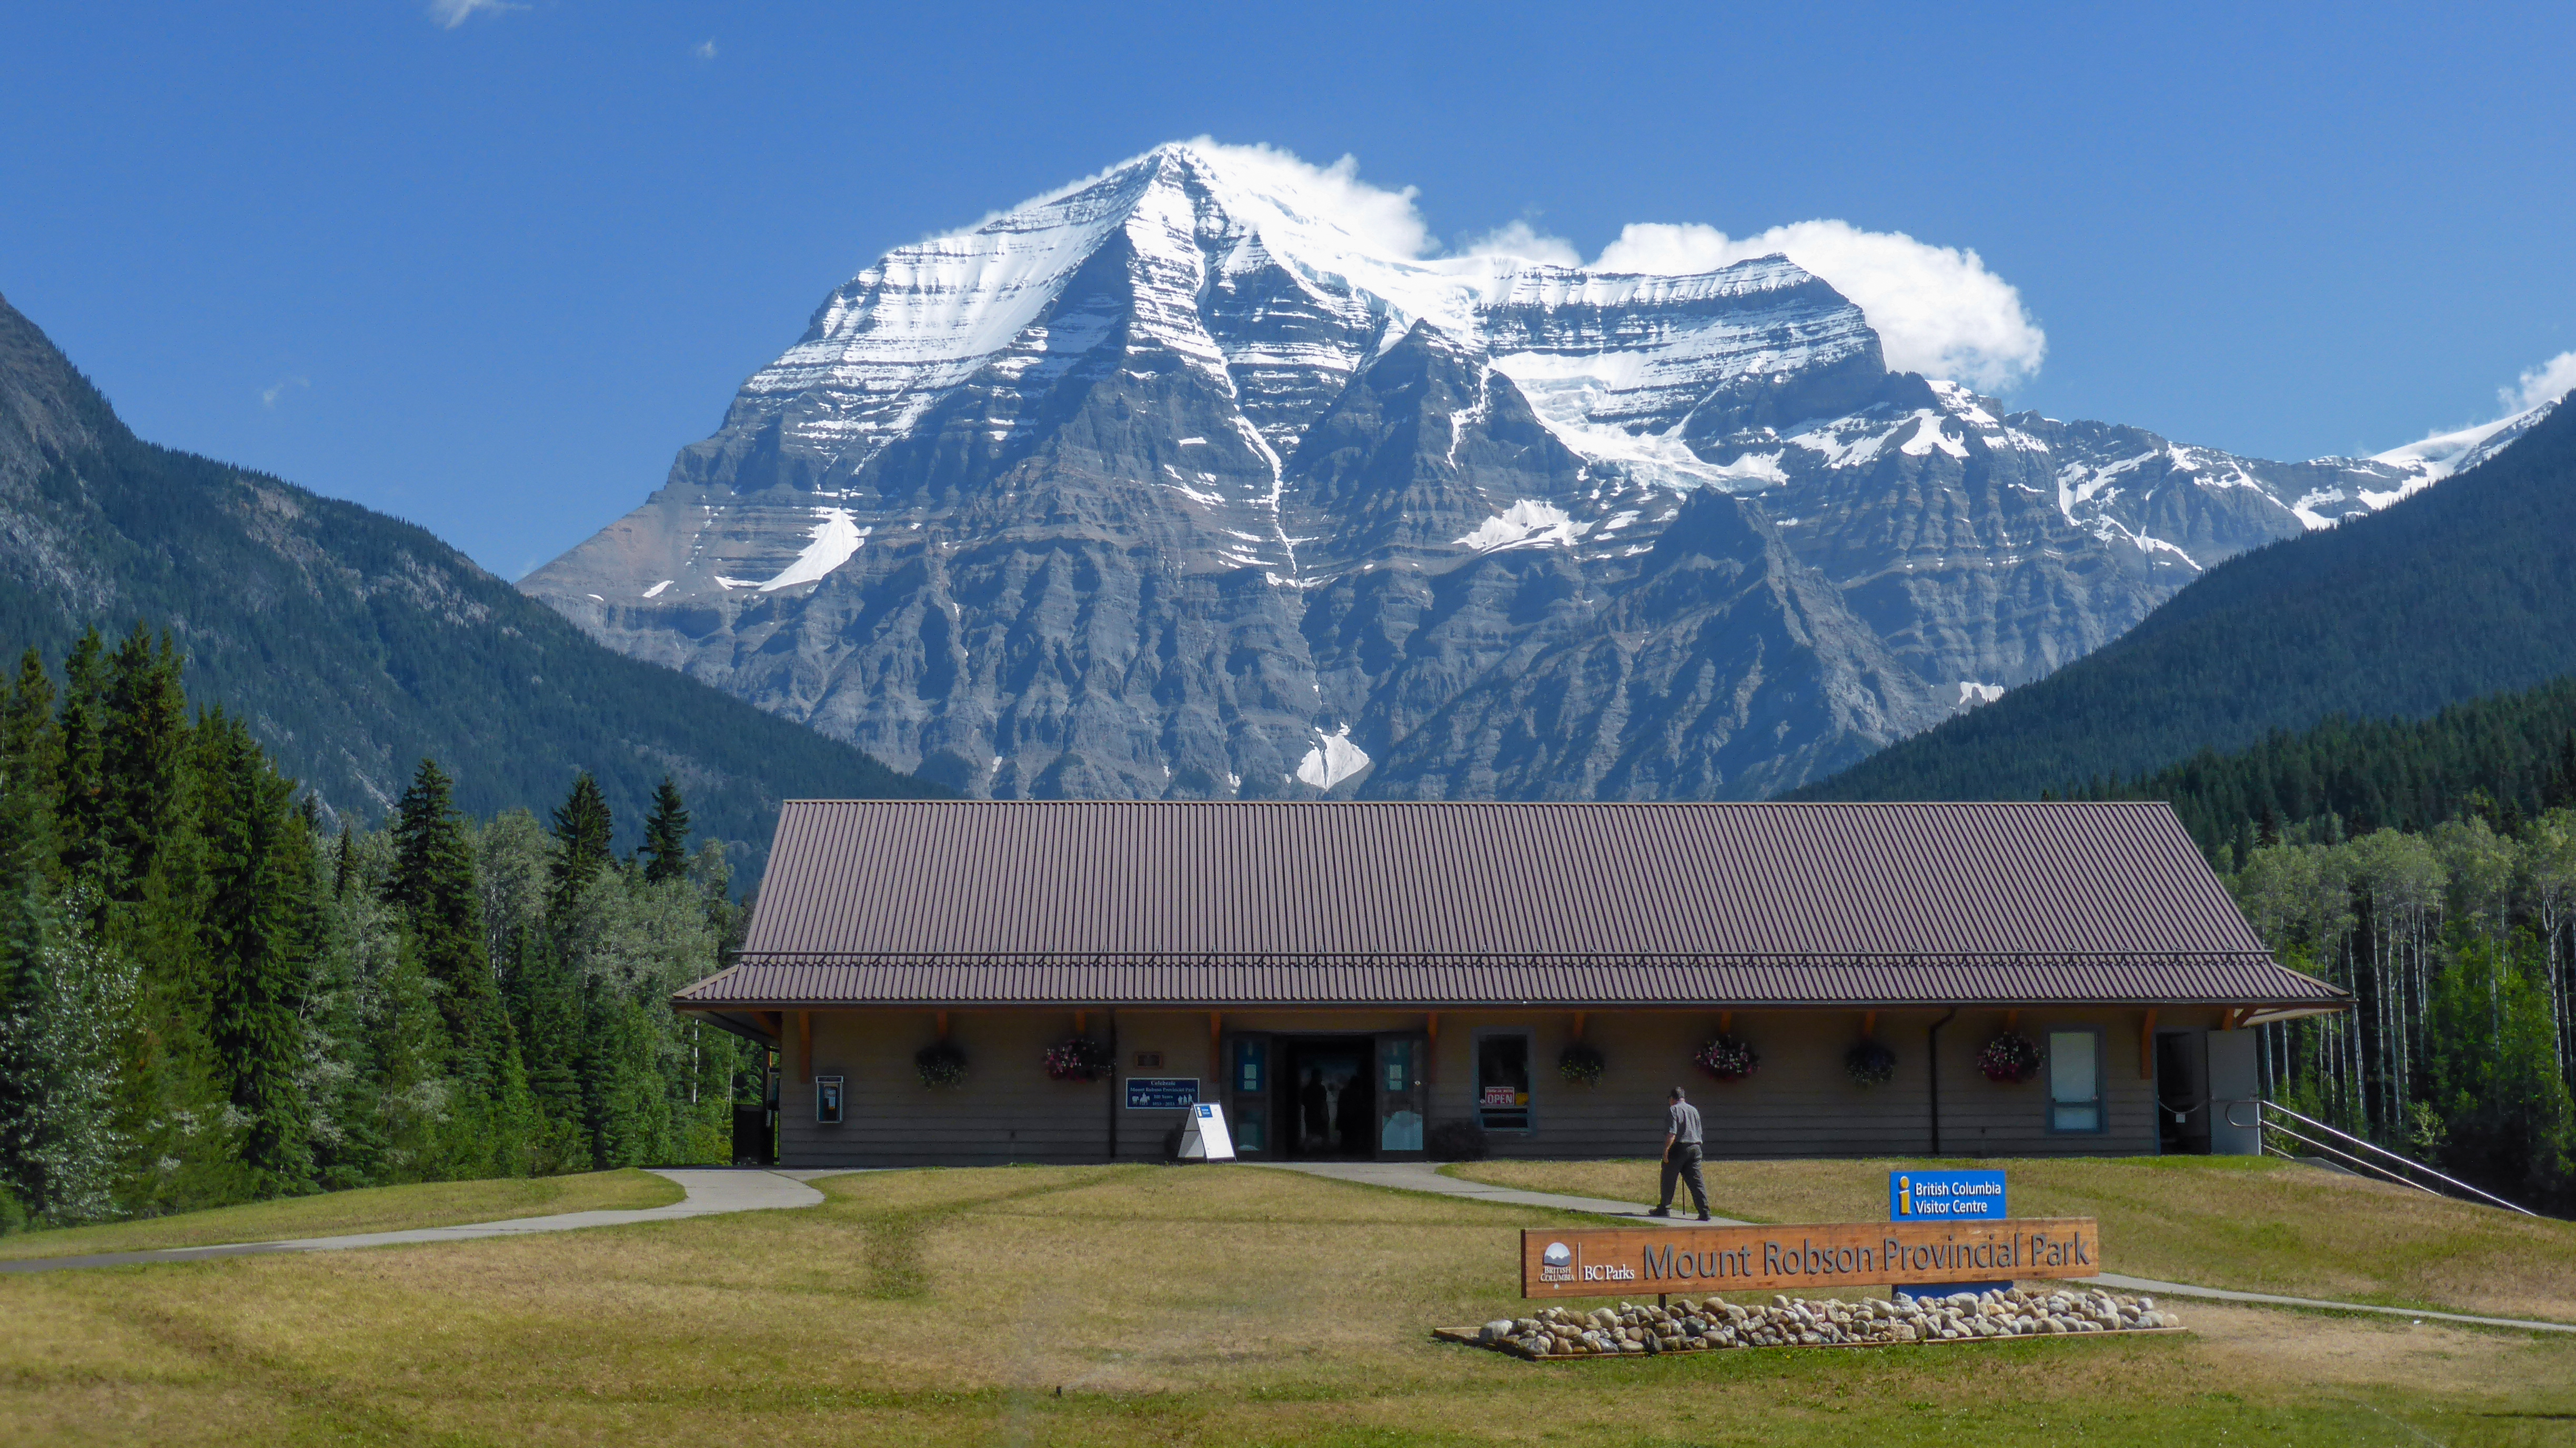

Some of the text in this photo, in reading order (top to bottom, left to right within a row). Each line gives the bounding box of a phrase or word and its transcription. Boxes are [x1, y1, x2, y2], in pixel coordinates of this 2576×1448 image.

[1487, 1094, 1513, 1104] OPEN
[1916, 1181, 2001, 1196] British Columbia
[1916, 1200, 1988, 1213] Visitor Centre
[1644, 1232, 2090, 1280] Mount Robson Provincial Park
[1584, 1264, 1635, 1281] BC Parks
